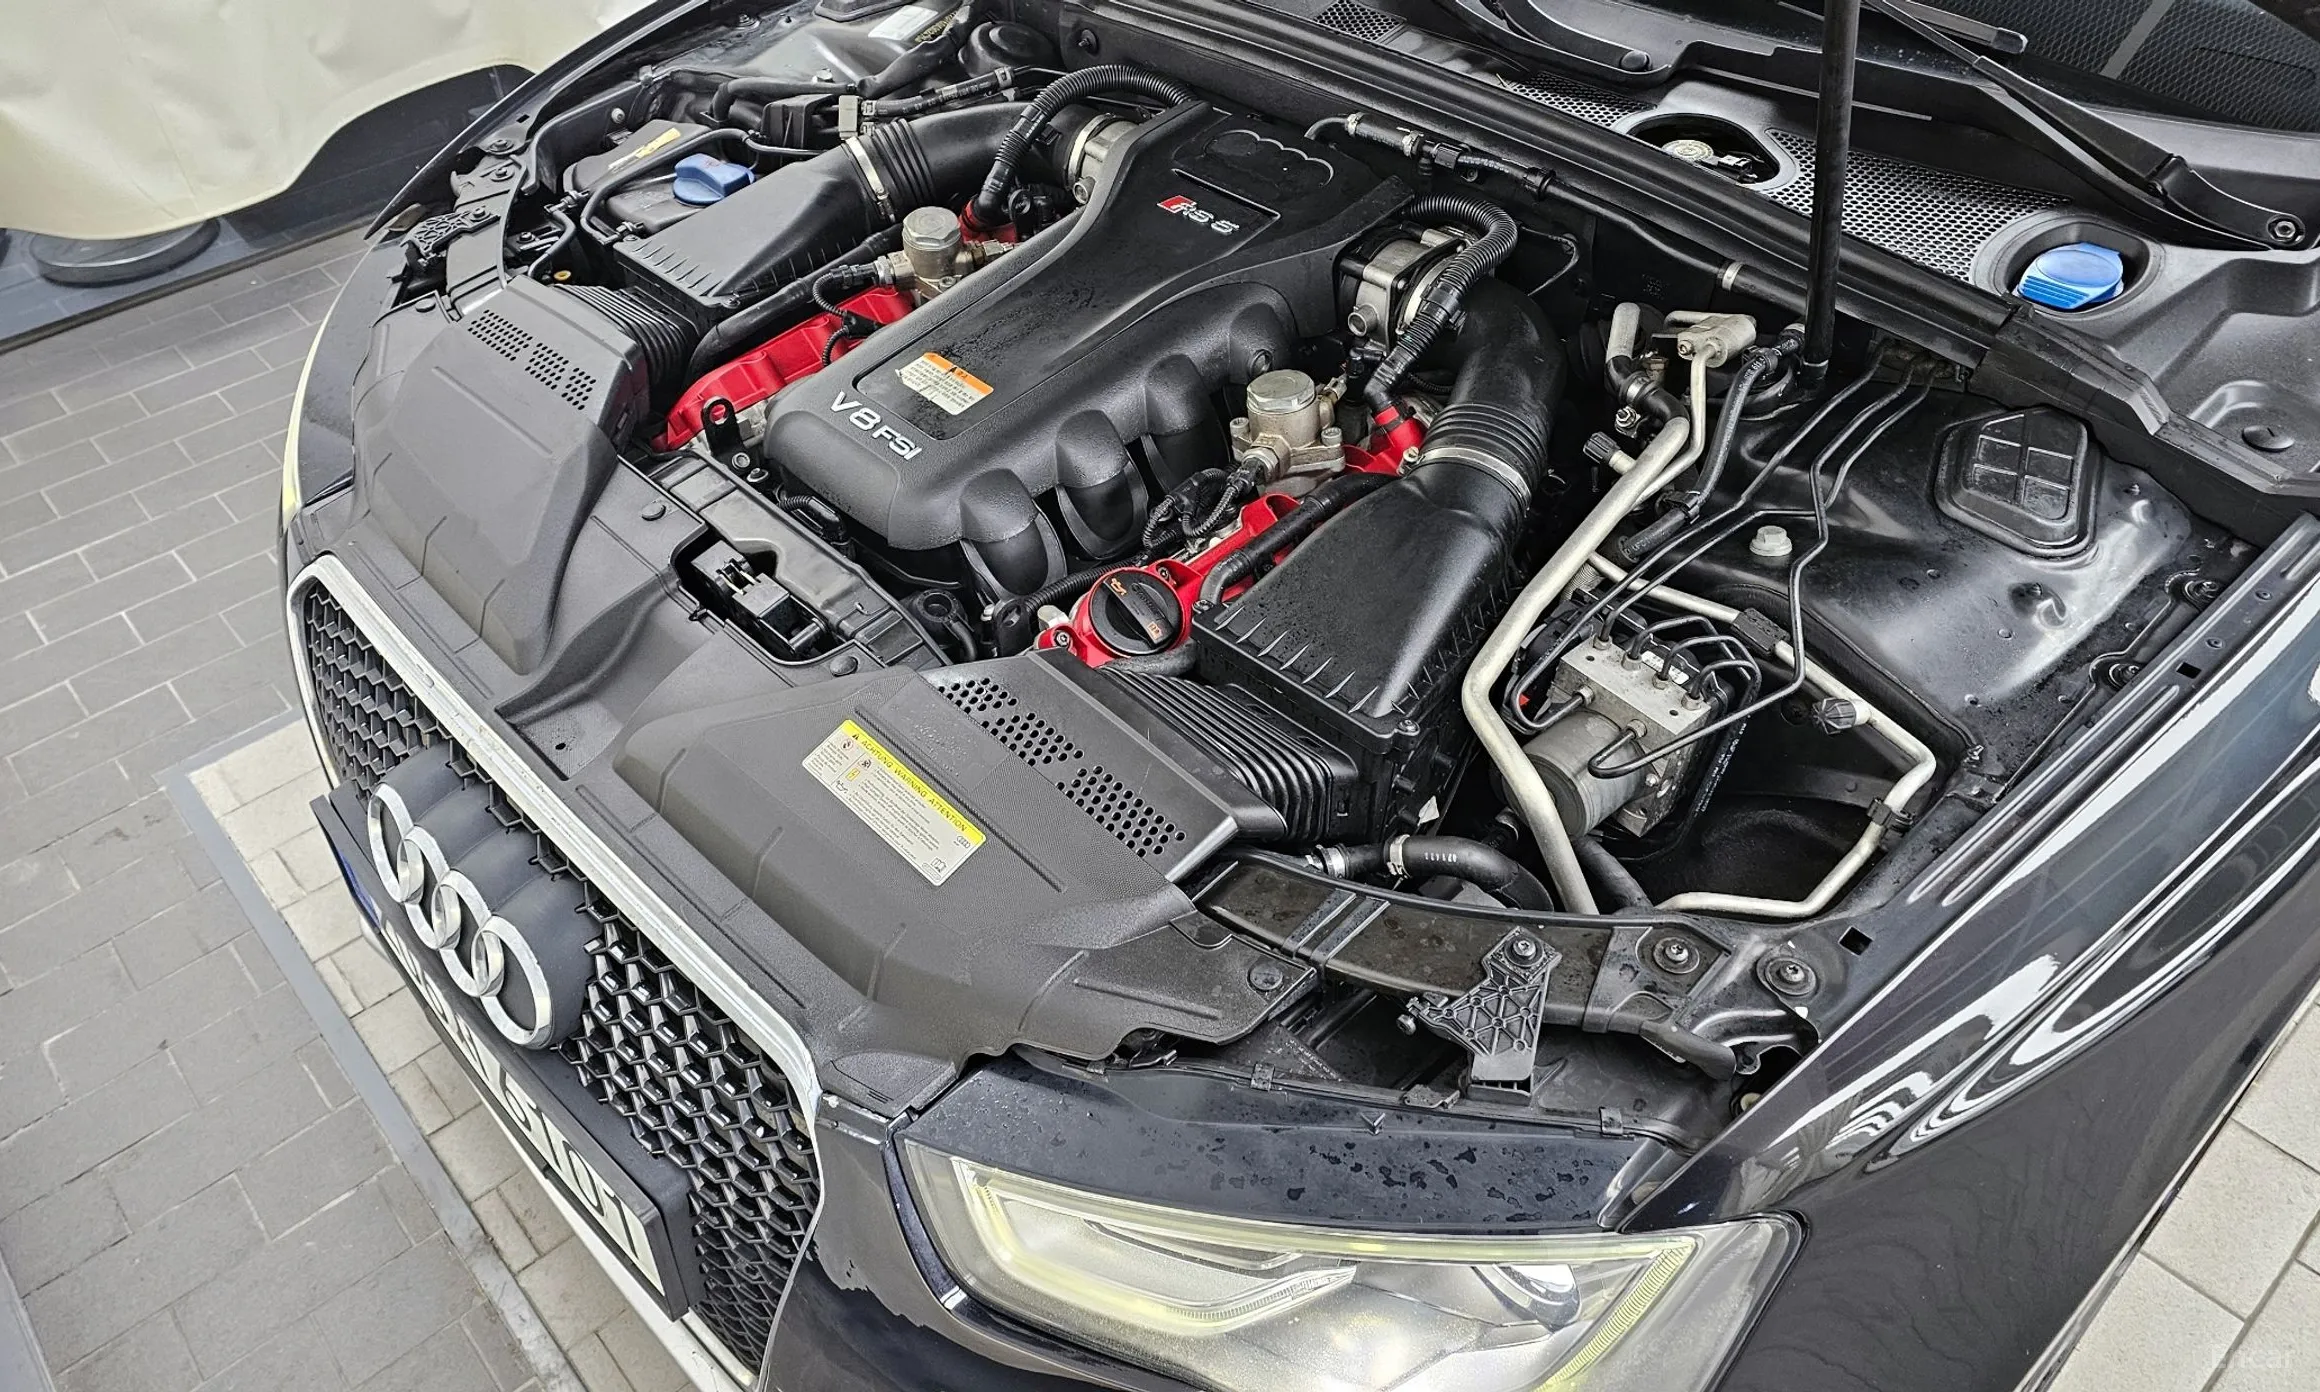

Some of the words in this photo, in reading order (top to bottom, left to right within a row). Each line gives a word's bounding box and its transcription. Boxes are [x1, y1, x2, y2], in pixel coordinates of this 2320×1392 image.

[830, 390, 882, 431] V8
[872, 425, 923, 461] FSI
[861, 740, 893, 769] ACHTUNG
[894, 767, 928, 798] WARNING
[928, 797, 968, 833] ATTENTION
